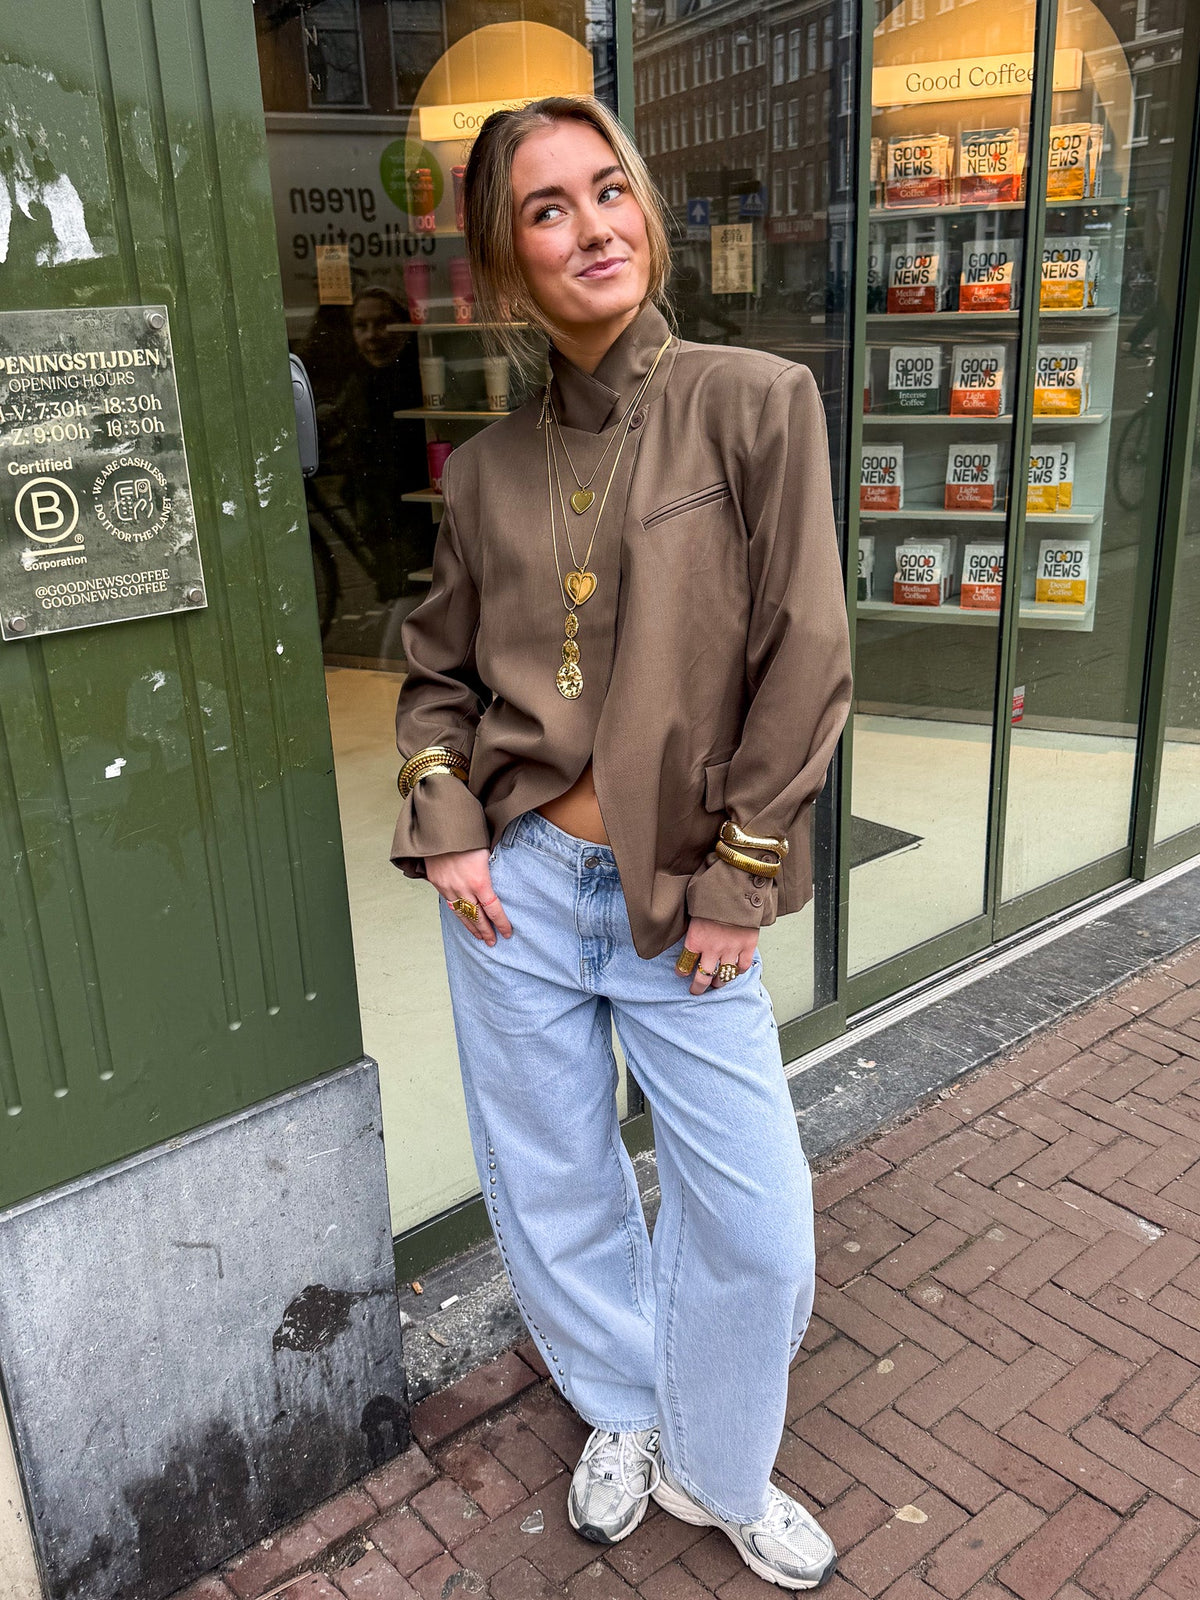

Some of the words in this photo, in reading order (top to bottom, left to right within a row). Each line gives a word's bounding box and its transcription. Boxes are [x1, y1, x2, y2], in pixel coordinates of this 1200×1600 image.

[905, 68, 961, 93] Good
[453, 108, 494, 131] Goo
[967, 141, 1008, 158] GOOD
[1050, 134, 1082, 152] OOD
[893, 145, 933, 162] GOOD
[1049, 150, 1080, 168] EWS
[893, 160, 933, 178] NEWS
[967, 157, 1007, 173] NEWS
[900, 188, 926, 198] Coffee
[895, 254, 932, 270] GOOD
[969, 251, 1008, 268] GOOD
[1043, 248, 1081, 264] GOOD
[893, 269, 930, 285] NEWS
[967, 267, 1005, 283] NEWS
[971, 295, 998, 304] Coffee
[895, 358, 934, 373] GOOD
[961, 358, 999, 374] GOOD
[1037, 357, 1079, 372] GOOD
[8, 374, 80, 393] OPENING
[82, 371, 135, 389] HOURS
[895, 372, 933, 387] NEWS
[959, 373, 996, 388] NEWS
[1036, 372, 1076, 387] NEWS
[899, 391, 927, 399] Intense
[965, 392, 986, 401] Light
[0, 403, 33, 423] -V:
[35, 399, 88, 421] 7:30h
[103, 393, 163, 415] 18:30h
[900, 399, 925, 407] Coffee
[962, 400, 987, 408] Coffee
[0, 428, 30, 447] -Z:
[33, 422, 91, 444] 9:00h
[7, 456, 73, 476] Certified
[861, 456, 897, 470] GOOD
[954, 454, 991, 468] GOOD
[1029, 455, 1055, 470] OOD
[92, 476, 106, 495] WE
[100, 460, 120, 480] ARE
[119, 456, 168, 487] CASHLESS
[860, 470, 896, 484] NEWS
[952, 468, 989, 483] NEWS
[1028, 470, 1053, 484] EWS
[956, 493, 981, 501] Coffee
[959, 486, 979, 494] Light
[864, 495, 888, 503] Coffee
[30, 490, 65, 531] B
[94, 503, 106, 521] DO
[101, 519, 114, 531] IT
[110, 527, 132, 542] FOR
[132, 529, 154, 543] THE
[151, 496, 172, 535] PLANET
[24, 554, 88, 572] Corporation
[900, 554, 936, 568] GOOD
[969, 555, 1004, 569] GOOD
[1044, 549, 1083, 564] GOOD
[899, 568, 934, 582] NEWS
[968, 569, 1004, 583] NEWS
[1043, 563, 1081, 578] NEWS
[35, 568, 171, 599] @GOODNEWSCOFFEE
[901, 585, 931, 593] Medium
[975, 586, 995, 595] Light
[41, 580, 168, 610] GOODNEWS.COFFEE
[903, 592, 928, 600] Coffee
[972, 593, 997, 602] Coffee
[1048, 588, 1073, 596] Coffee
